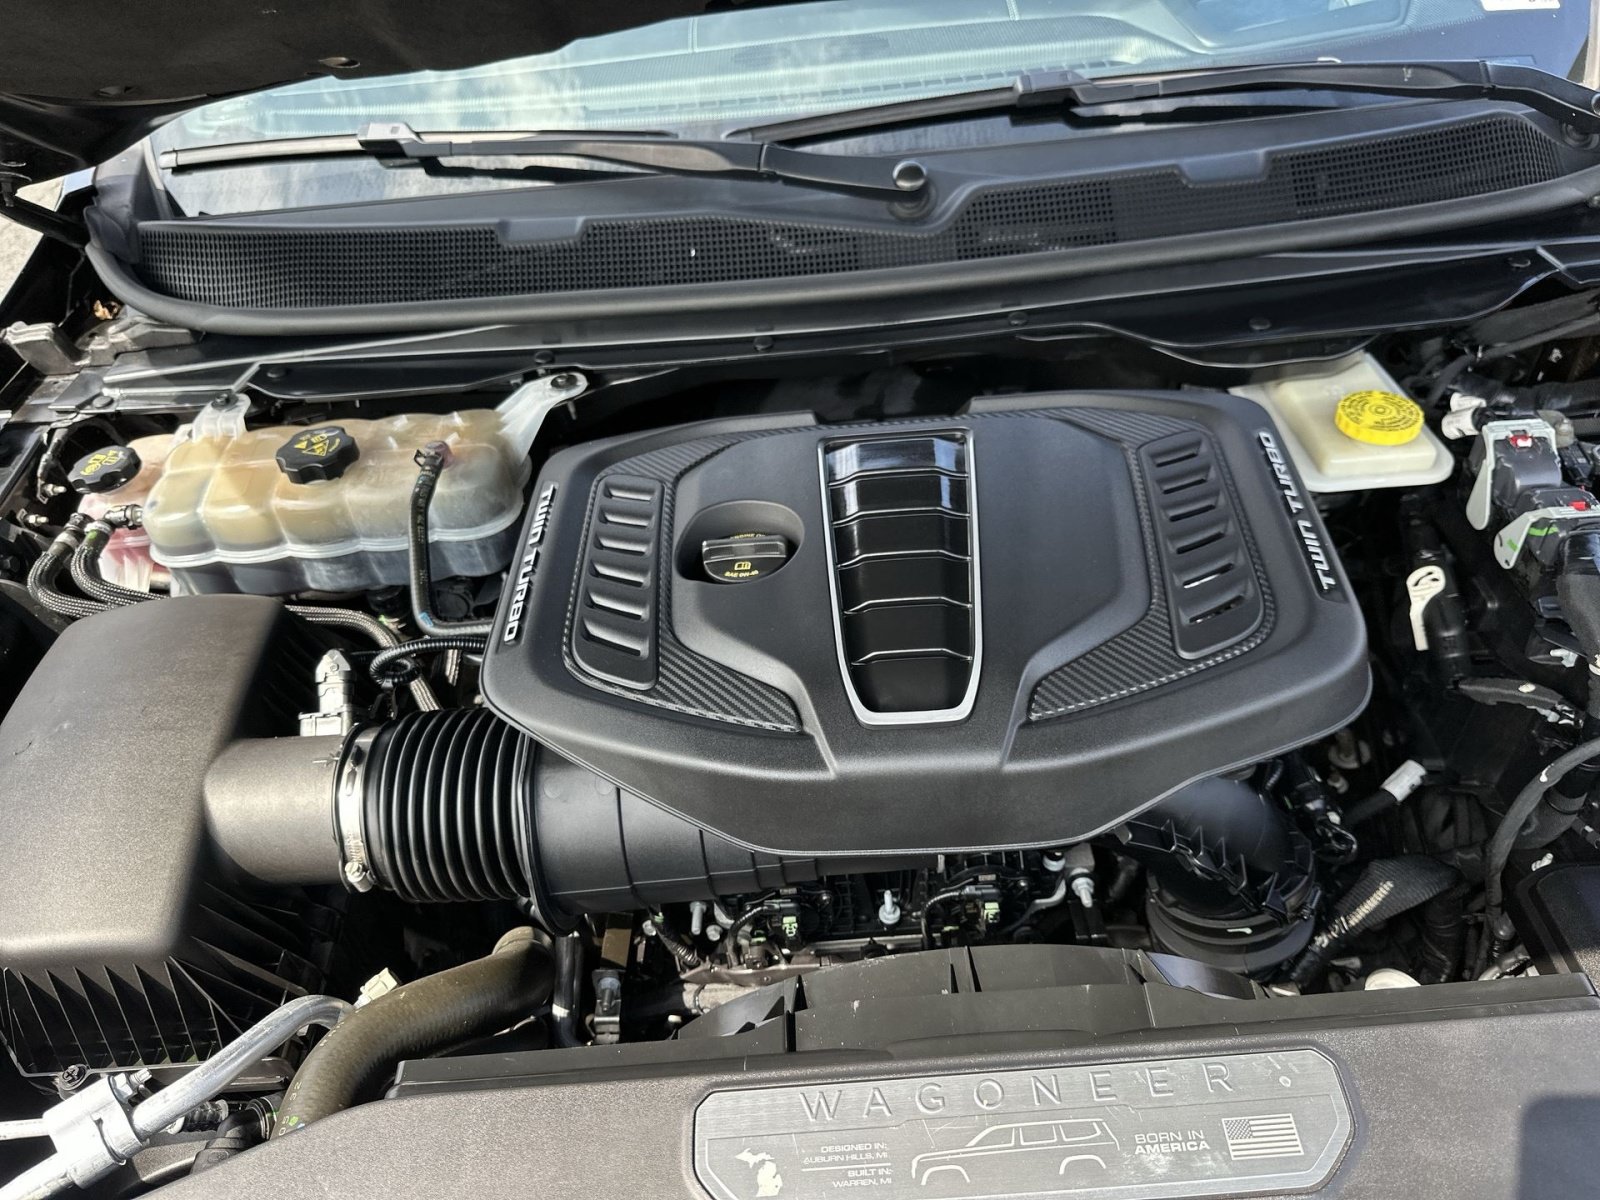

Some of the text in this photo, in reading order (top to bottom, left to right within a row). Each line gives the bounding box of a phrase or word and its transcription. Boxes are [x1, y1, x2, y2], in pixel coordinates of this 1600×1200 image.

[1259, 431, 1335, 590] TWIN TURBO
[504, 484, 554, 642] TWIN TURBO
[800, 1061, 1234, 1122] WAGONEER
[1134, 1130, 1206, 1144] BORN IN
[820, 1142, 888, 1154] DESIGNED IN:
[1135, 1140, 1211, 1155] AMERICA
[803, 1151, 888, 1165] AUBURN HILLS, MI
[847, 1168, 877, 1177] BUILT
[832, 1177, 892, 1188] WARREN, MI
